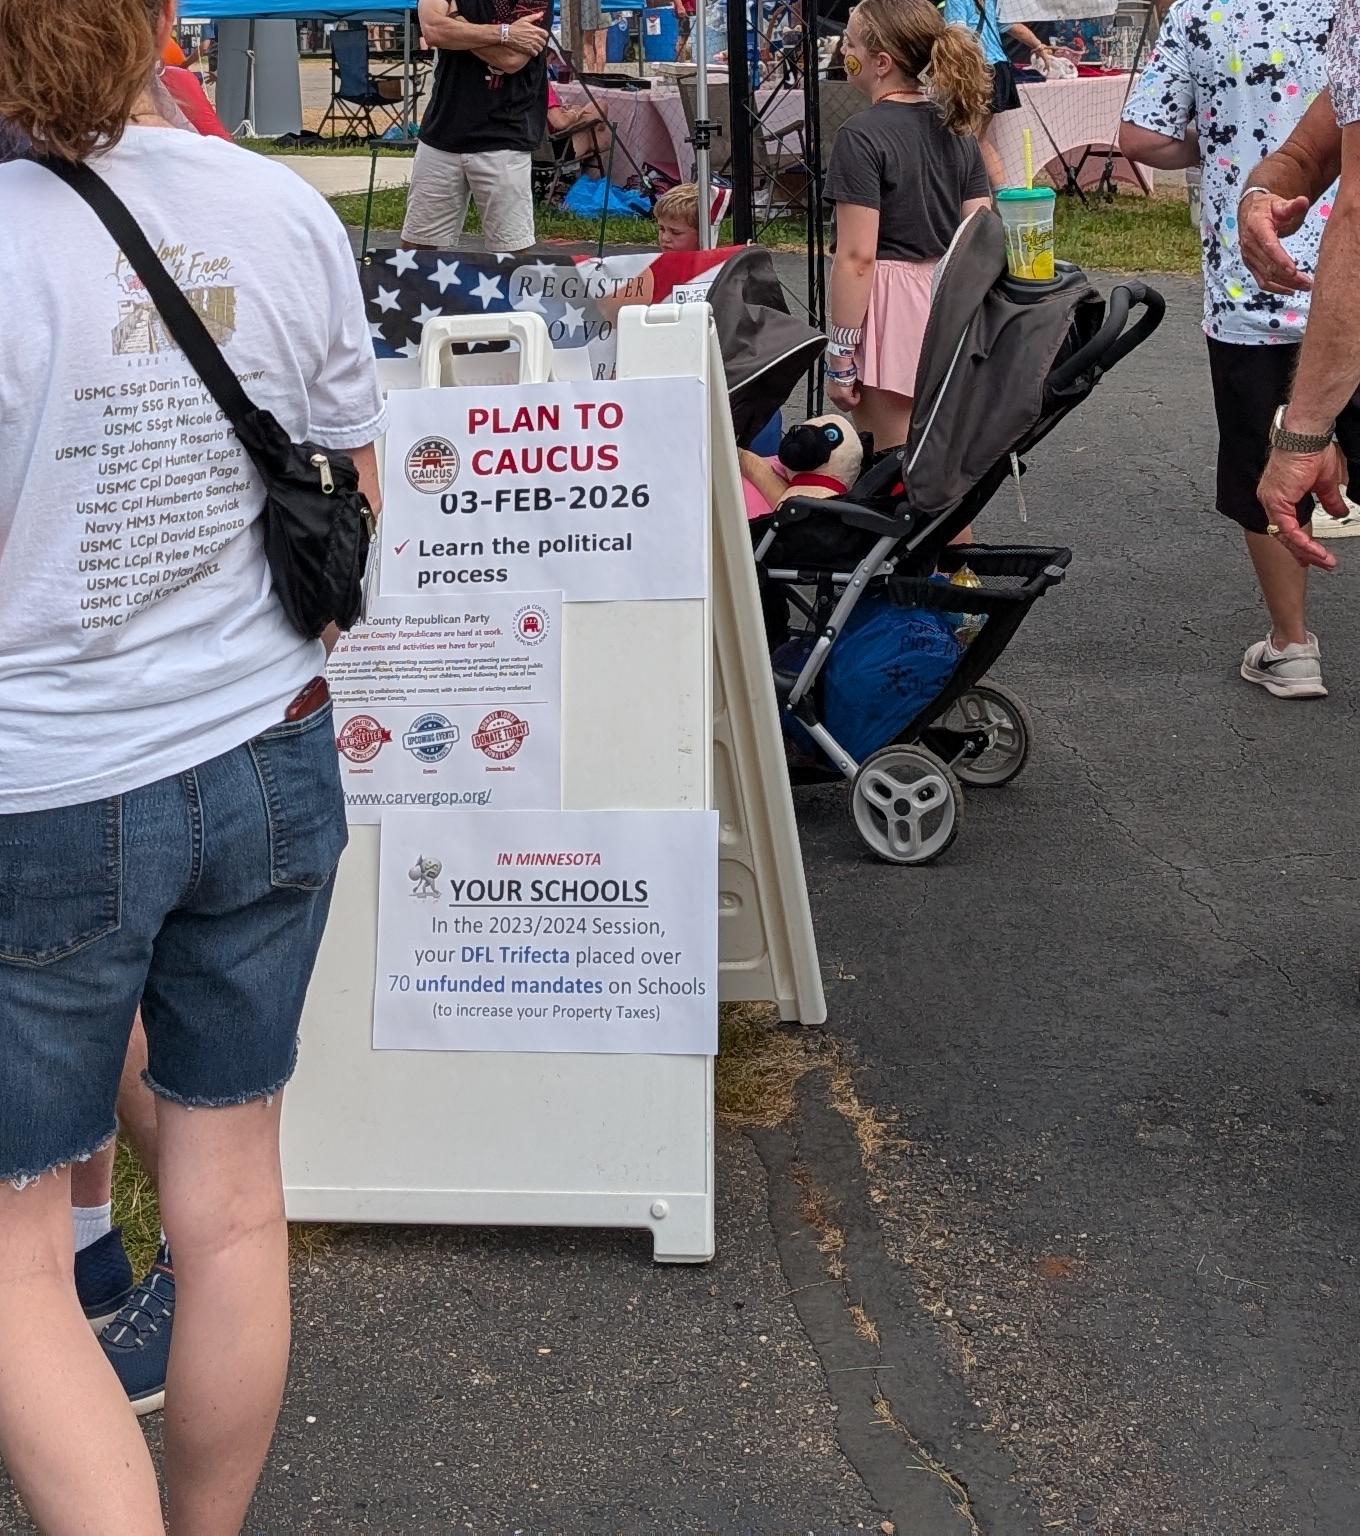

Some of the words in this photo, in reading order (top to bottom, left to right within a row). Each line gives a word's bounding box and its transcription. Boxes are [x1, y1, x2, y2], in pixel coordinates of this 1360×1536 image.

[187, 251, 230, 280] Free
[516, 275, 648, 300] REGISTER
[74, 385, 116, 402] USMC
[120, 382, 147, 397] SSgt
[149, 377, 180, 393] Darin
[103, 402, 139, 418] Army
[142, 399, 165, 413] SSG
[167, 395, 199, 411] Ryan
[467, 404, 561, 436] PLAN
[574, 401, 624, 431] TO
[104, 420, 143, 436] USMC
[146, 416, 173, 432] SSgt
[176, 411, 213, 427] Nicole
[55, 444, 97, 461] USMC
[101, 442, 125, 458] Sgt
[128, 436, 177, 454] Johanny
[180, 431, 224, 445] Rosario
[98, 459, 138, 475] USMC
[141, 456, 163, 471] Cpl
[165, 450, 203, 466] Hunter
[206, 447, 242, 462] Lopez
[470, 444, 620, 477] CAUCUS
[96, 479, 137, 495] USMC
[140, 476, 162, 492] Cpl
[164, 468, 207, 485] Daegan
[209, 465, 240, 479] Page
[411, 468, 453, 479] CAUCUS
[76, 501, 118, 515] USMC
[121, 498, 143, 512] Cpl
[146, 490, 203, 508] Humberto
[206, 480, 251, 497] Sanchez
[440, 484, 651, 515] 03-FEB-2026
[85, 520, 123, 535] Navy
[126, 514, 156, 530] HM3
[159, 509, 204, 526] Maxton
[206, 497, 240, 517] Soviak
[80, 539, 123, 553] USMC
[130, 532, 158, 548] LCpl
[161, 527, 195, 544] David
[198, 518, 245, 537] Espinoza
[418, 538, 485, 558] Learn
[492, 535, 531, 555] the
[537, 532, 633, 558] political
[78, 558, 121, 572] USMC
[124, 552, 152, 568] LCpl
[155, 547, 189, 564] Rylee
[86, 575, 128, 591] USMC
[131, 570, 160, 586] LCpl
[162, 565, 194, 582] Dylan
[417, 567, 509, 589] process
[80, 595, 122, 610] USMC
[126, 590, 153, 607] LCpl
[81, 615, 123, 630] USMC
[367, 615, 402, 628] County
[404, 614, 461, 628] Republican
[464, 613, 490, 626] Party
[348, 631, 370, 640] Carver
[371, 630, 396, 640] County
[398, 629, 442, 639] Republicans
[456, 628, 473, 637] hard
[350, 644, 362, 652] the
[363, 644, 385, 652] events
[387, 643, 401, 651] and
[402, 642, 435, 651] activities
[448, 641, 465, 650] have
[467, 641, 478, 649] for
[479, 640, 496, 650] you!
[503, 722, 527, 740] TODAY
[497, 852, 512, 865] IN
[515, 852, 602, 866] MINNESOTA
[450, 879, 523, 902] YOUR
[530, 879, 648, 903] SCHOOLS
[431, 916, 448, 934] In
[453, 916, 483, 934] the
[489, 915, 587, 937] 2023/2024
[592, 916, 666, 938] Session,
[414, 949, 456, 967] your
[461, 946, 495, 964] DFL
[499, 945, 570, 964] Trifecta
[575, 946, 636, 967] placed
[640, 950, 682, 965] over
[388, 975, 410, 992] 70
[415, 975, 505, 993] unfunded
[511, 976, 603, 995] mandates
[608, 980, 632, 995] on
[637, 976, 706, 996] Schools
[432, 1002, 453, 1020] (to
[456, 1003, 513, 1019] increase
[516, 1005, 549, 1021] your
[552, 1004, 613, 1022] Property
[615, 1004, 661, 1022] Taxes)
